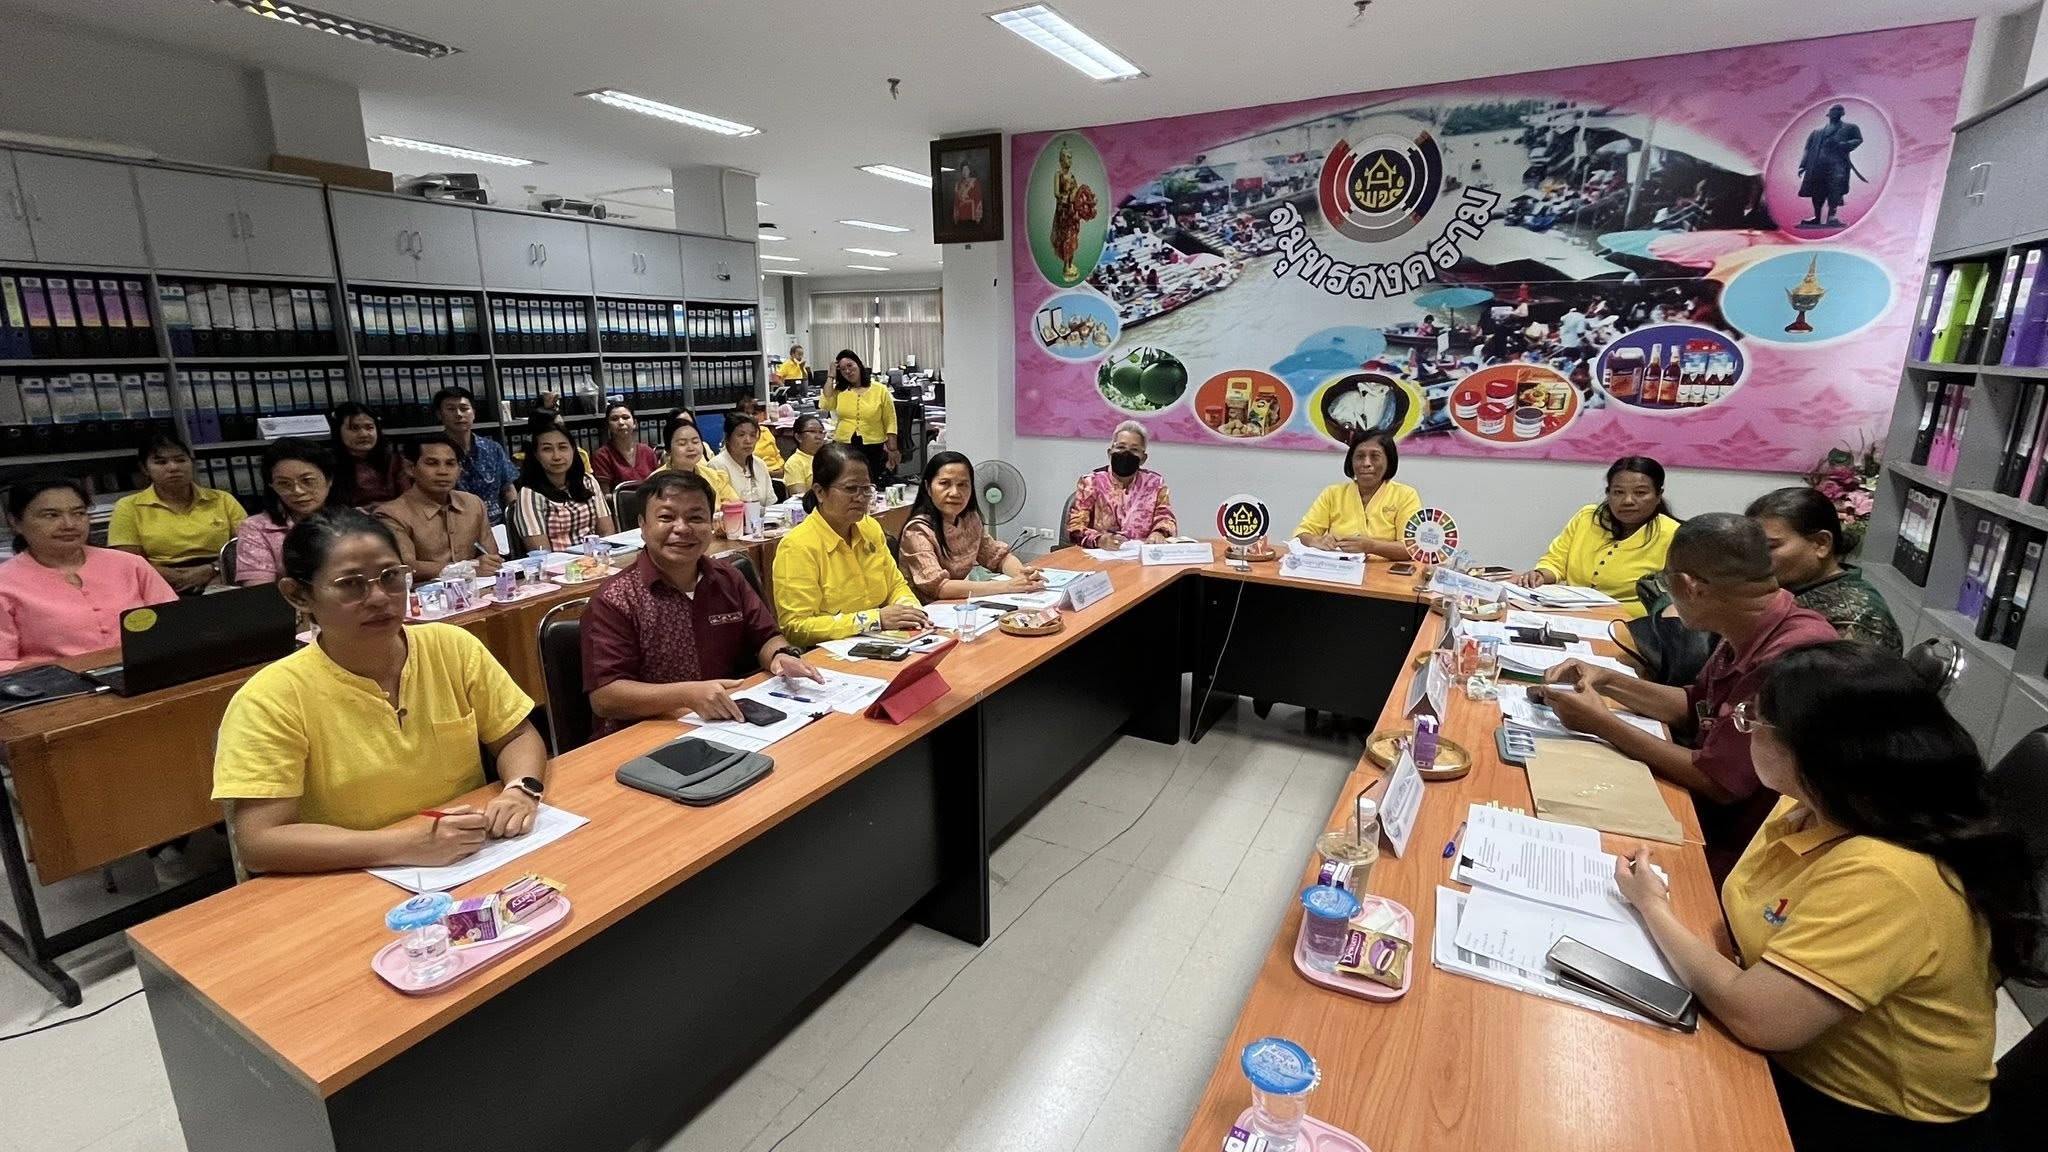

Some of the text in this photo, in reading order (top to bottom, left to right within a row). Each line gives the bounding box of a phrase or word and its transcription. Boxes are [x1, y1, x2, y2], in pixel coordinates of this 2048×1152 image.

[1269, 186, 1501, 299] สมุทรสงคราม
